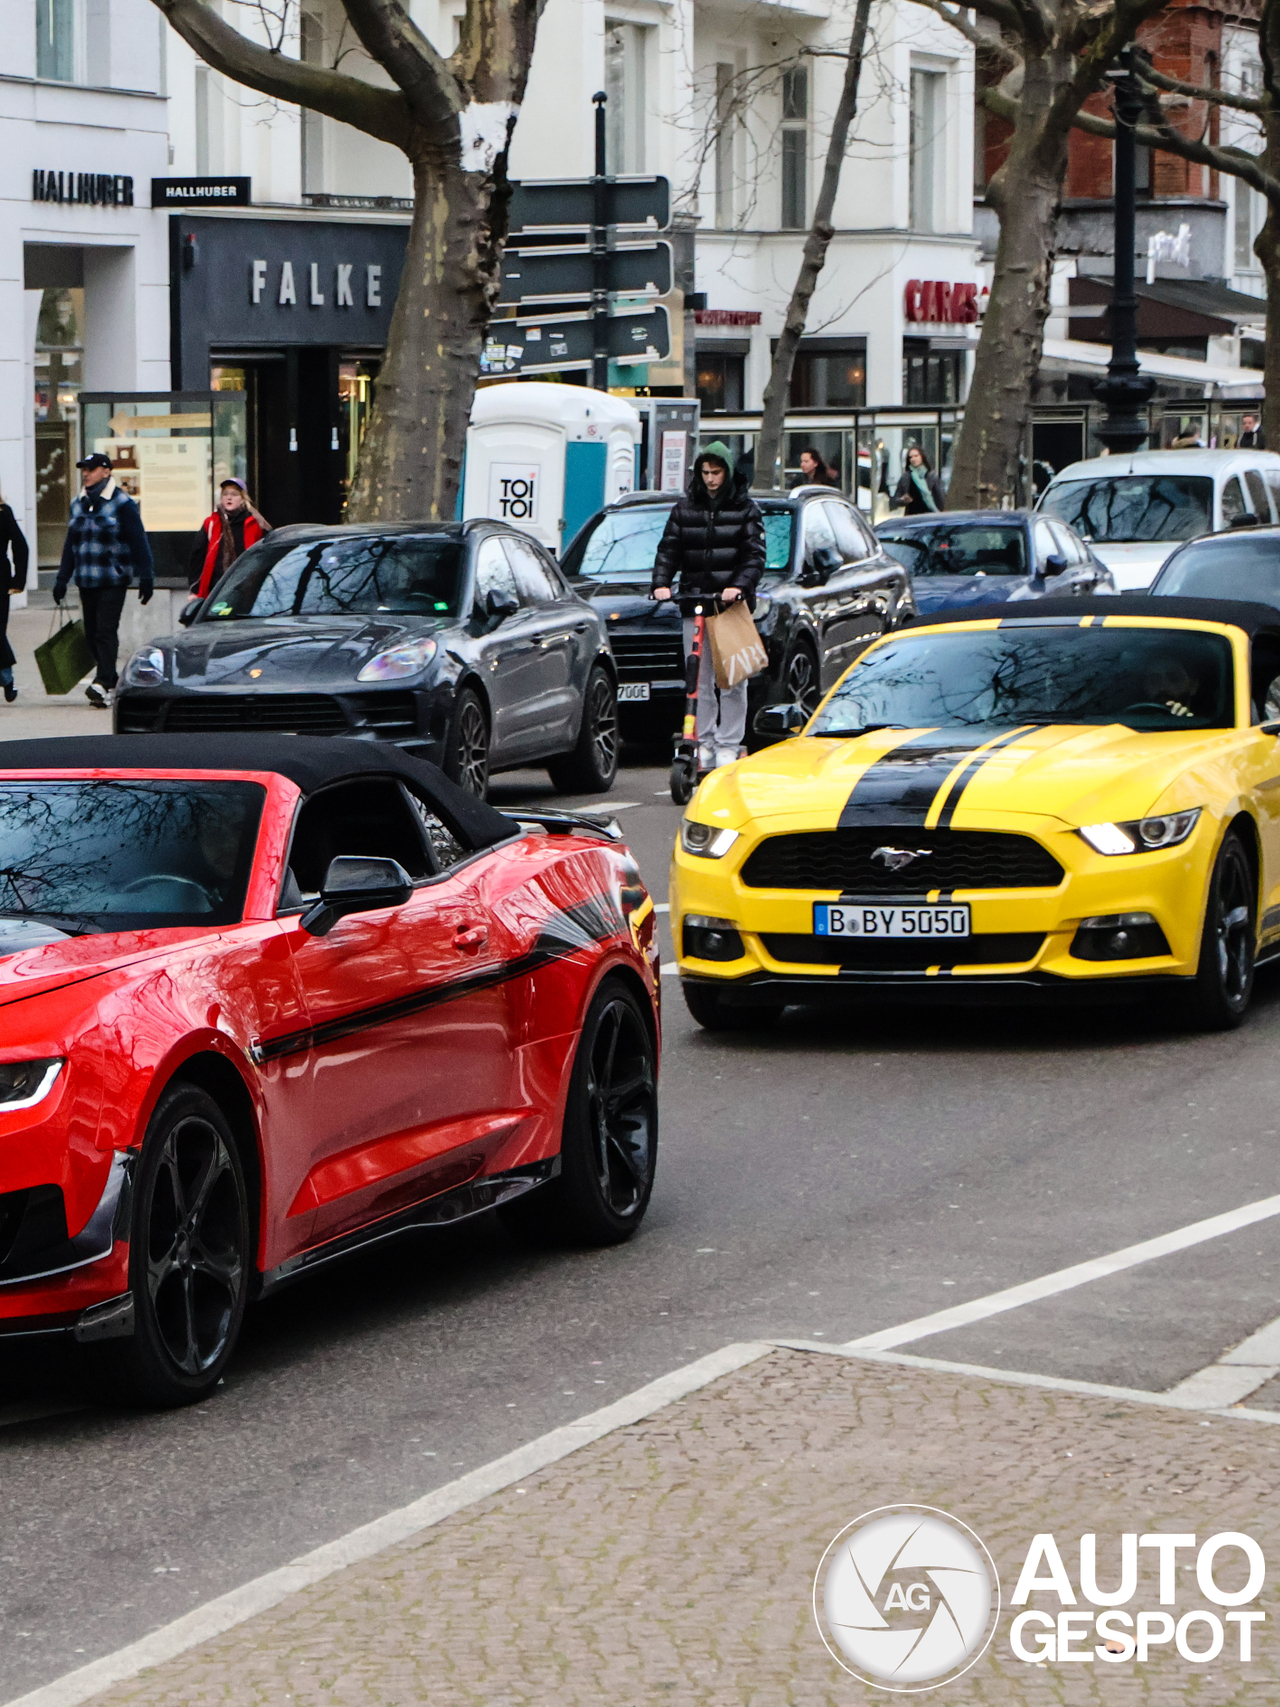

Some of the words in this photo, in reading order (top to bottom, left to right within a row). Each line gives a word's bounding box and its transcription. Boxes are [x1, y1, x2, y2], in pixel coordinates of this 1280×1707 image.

[33, 168, 134, 207] HALLHUBER
[165, 185, 238, 198] HALLHUBER
[252, 259, 383, 307] FALKE
[500, 478, 534, 499] TOI
[499, 499, 533, 518] TOI
[830, 909, 845, 933] B
[863, 910, 895, 934] BY
[902, 910, 966, 934] 5050
